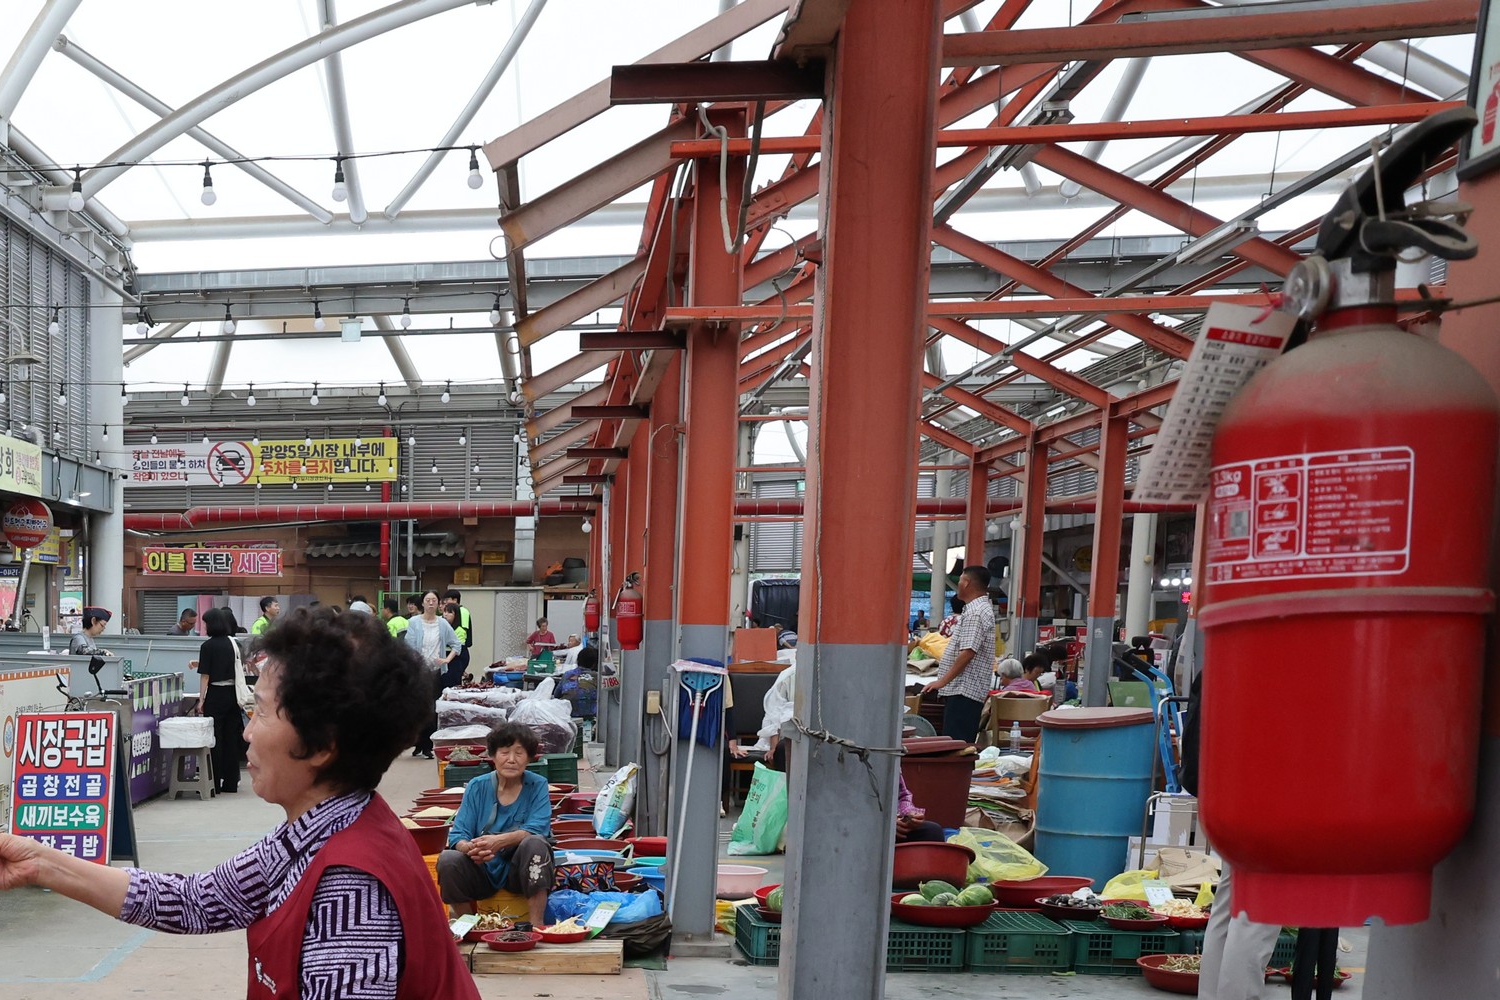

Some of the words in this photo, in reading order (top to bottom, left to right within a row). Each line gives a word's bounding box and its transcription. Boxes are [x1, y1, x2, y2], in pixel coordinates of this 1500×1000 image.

[260, 443, 339, 459] 광양5일시장
[343, 442, 385, 457] 내부에
[148, 552, 187, 573] 이불
[192, 552, 233, 574] 폭탄
[238, 552, 278, 574] 세일
[19, 718, 108, 769] 시장국밥
[20, 805, 100, 827] 새끼보수육
